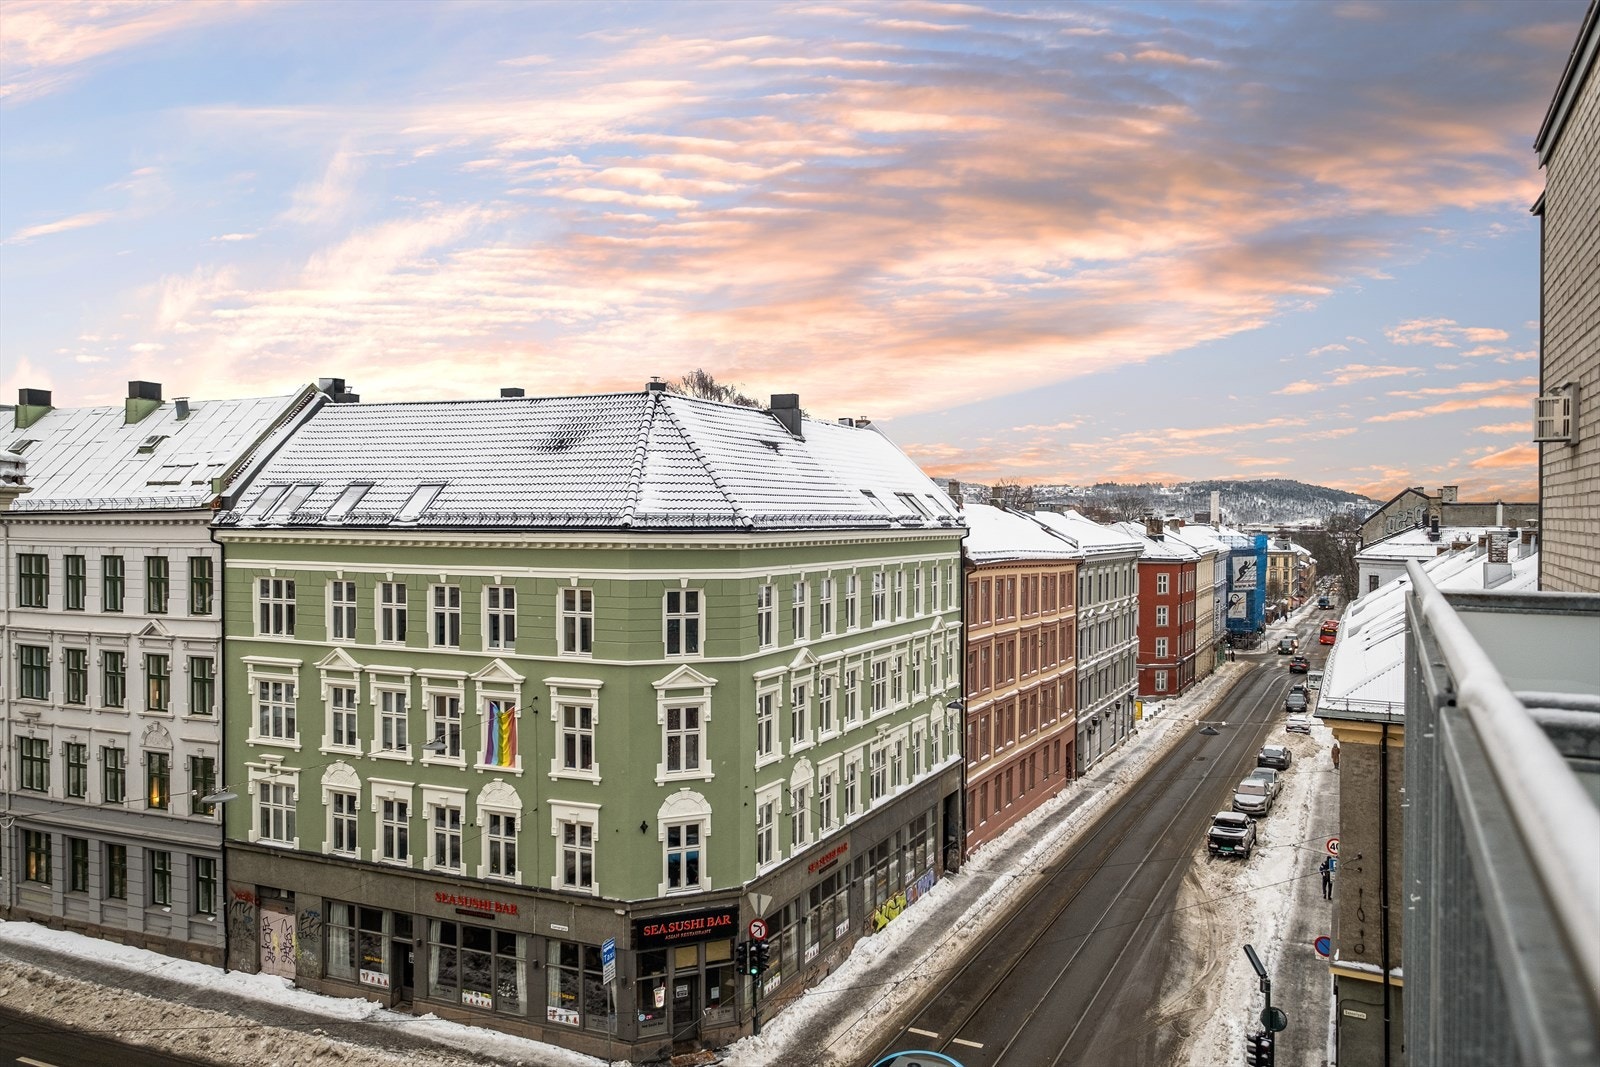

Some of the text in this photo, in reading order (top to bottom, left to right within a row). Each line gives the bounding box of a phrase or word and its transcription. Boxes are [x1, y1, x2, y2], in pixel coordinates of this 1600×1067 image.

[435, 892, 455, 904] SEA
[456, 896, 491, 911] SUSHI
[494, 901, 518, 915] BAR
[643, 914, 732, 937] SEA SUSHI BAR
[665, 928, 712, 940] ASIAN RESTAURANT
